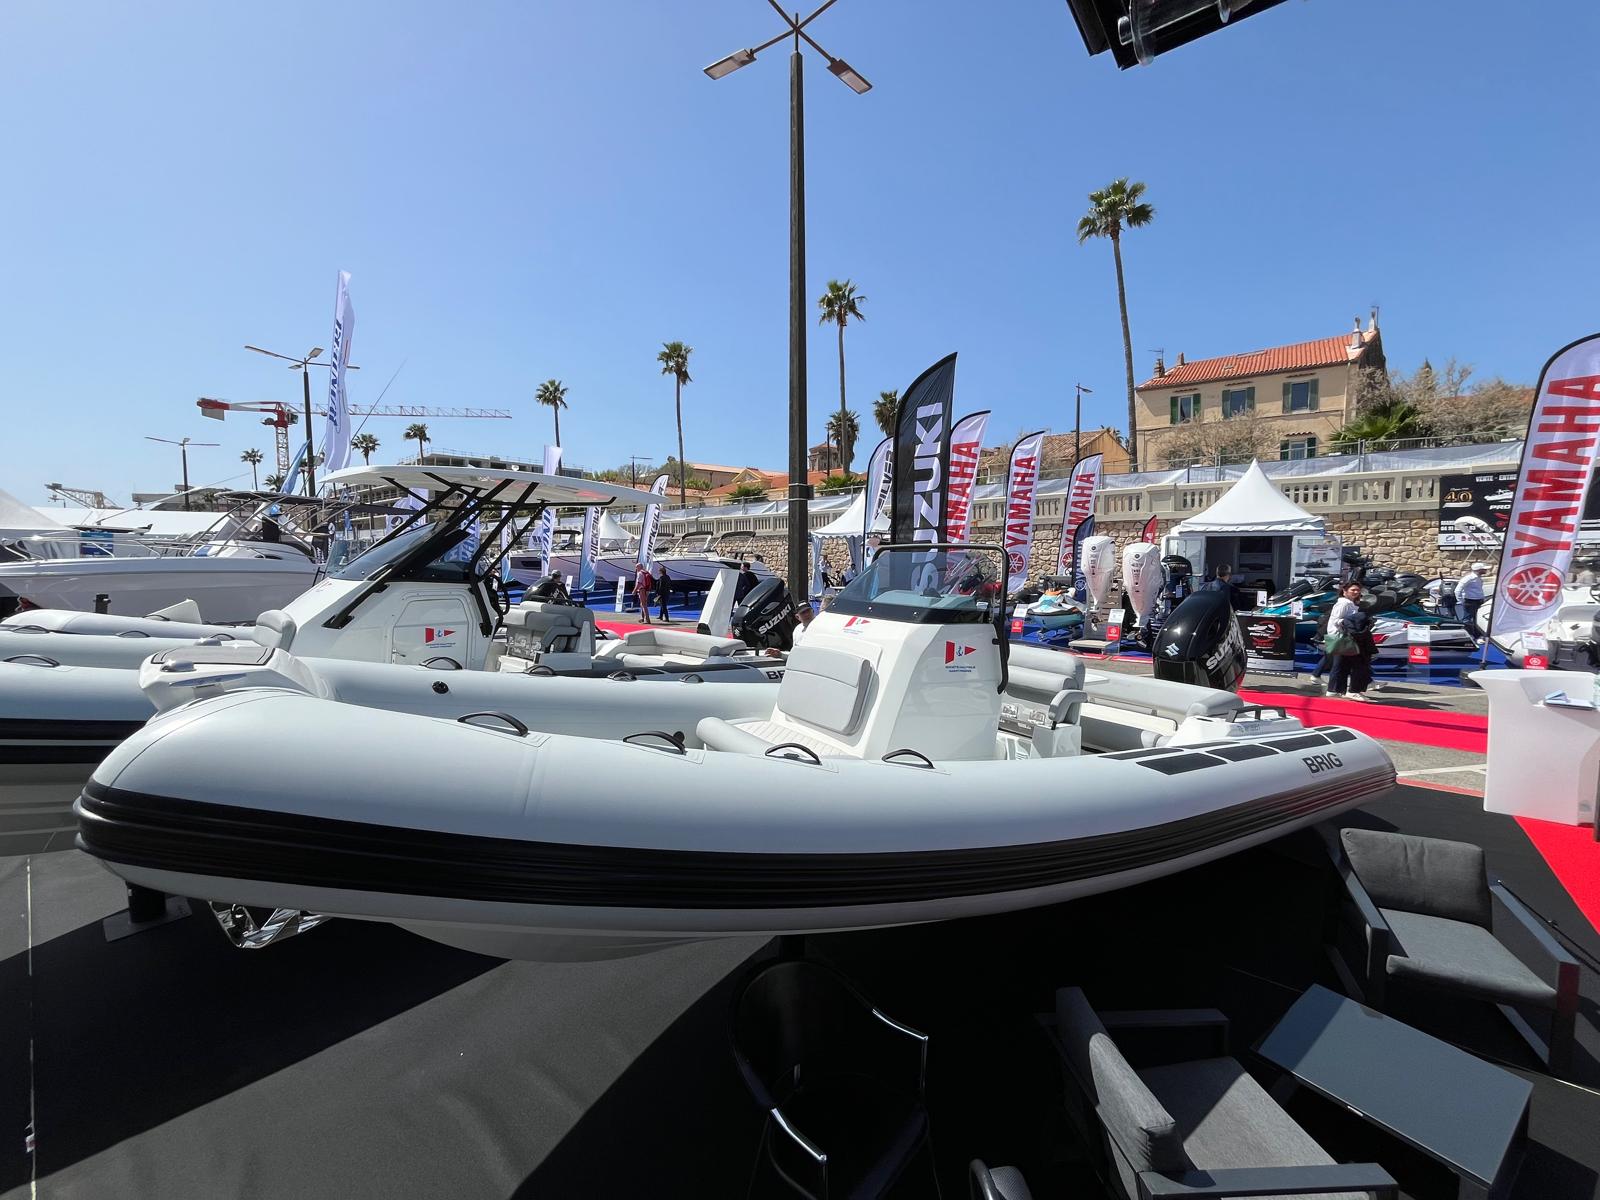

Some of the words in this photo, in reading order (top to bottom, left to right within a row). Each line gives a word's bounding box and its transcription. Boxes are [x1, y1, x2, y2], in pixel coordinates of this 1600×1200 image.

[1511, 374, 1600, 558] YAMAHA
[911, 402, 943, 592] SUZUKI
[1005, 455, 1037, 549] YAMAHA
[1443, 491, 1473, 502] 40
[590, 506, 600, 564] QUICKSILV
[758, 603, 792, 635] SUZUKI
[1302, 752, 1344, 774] BRIG
